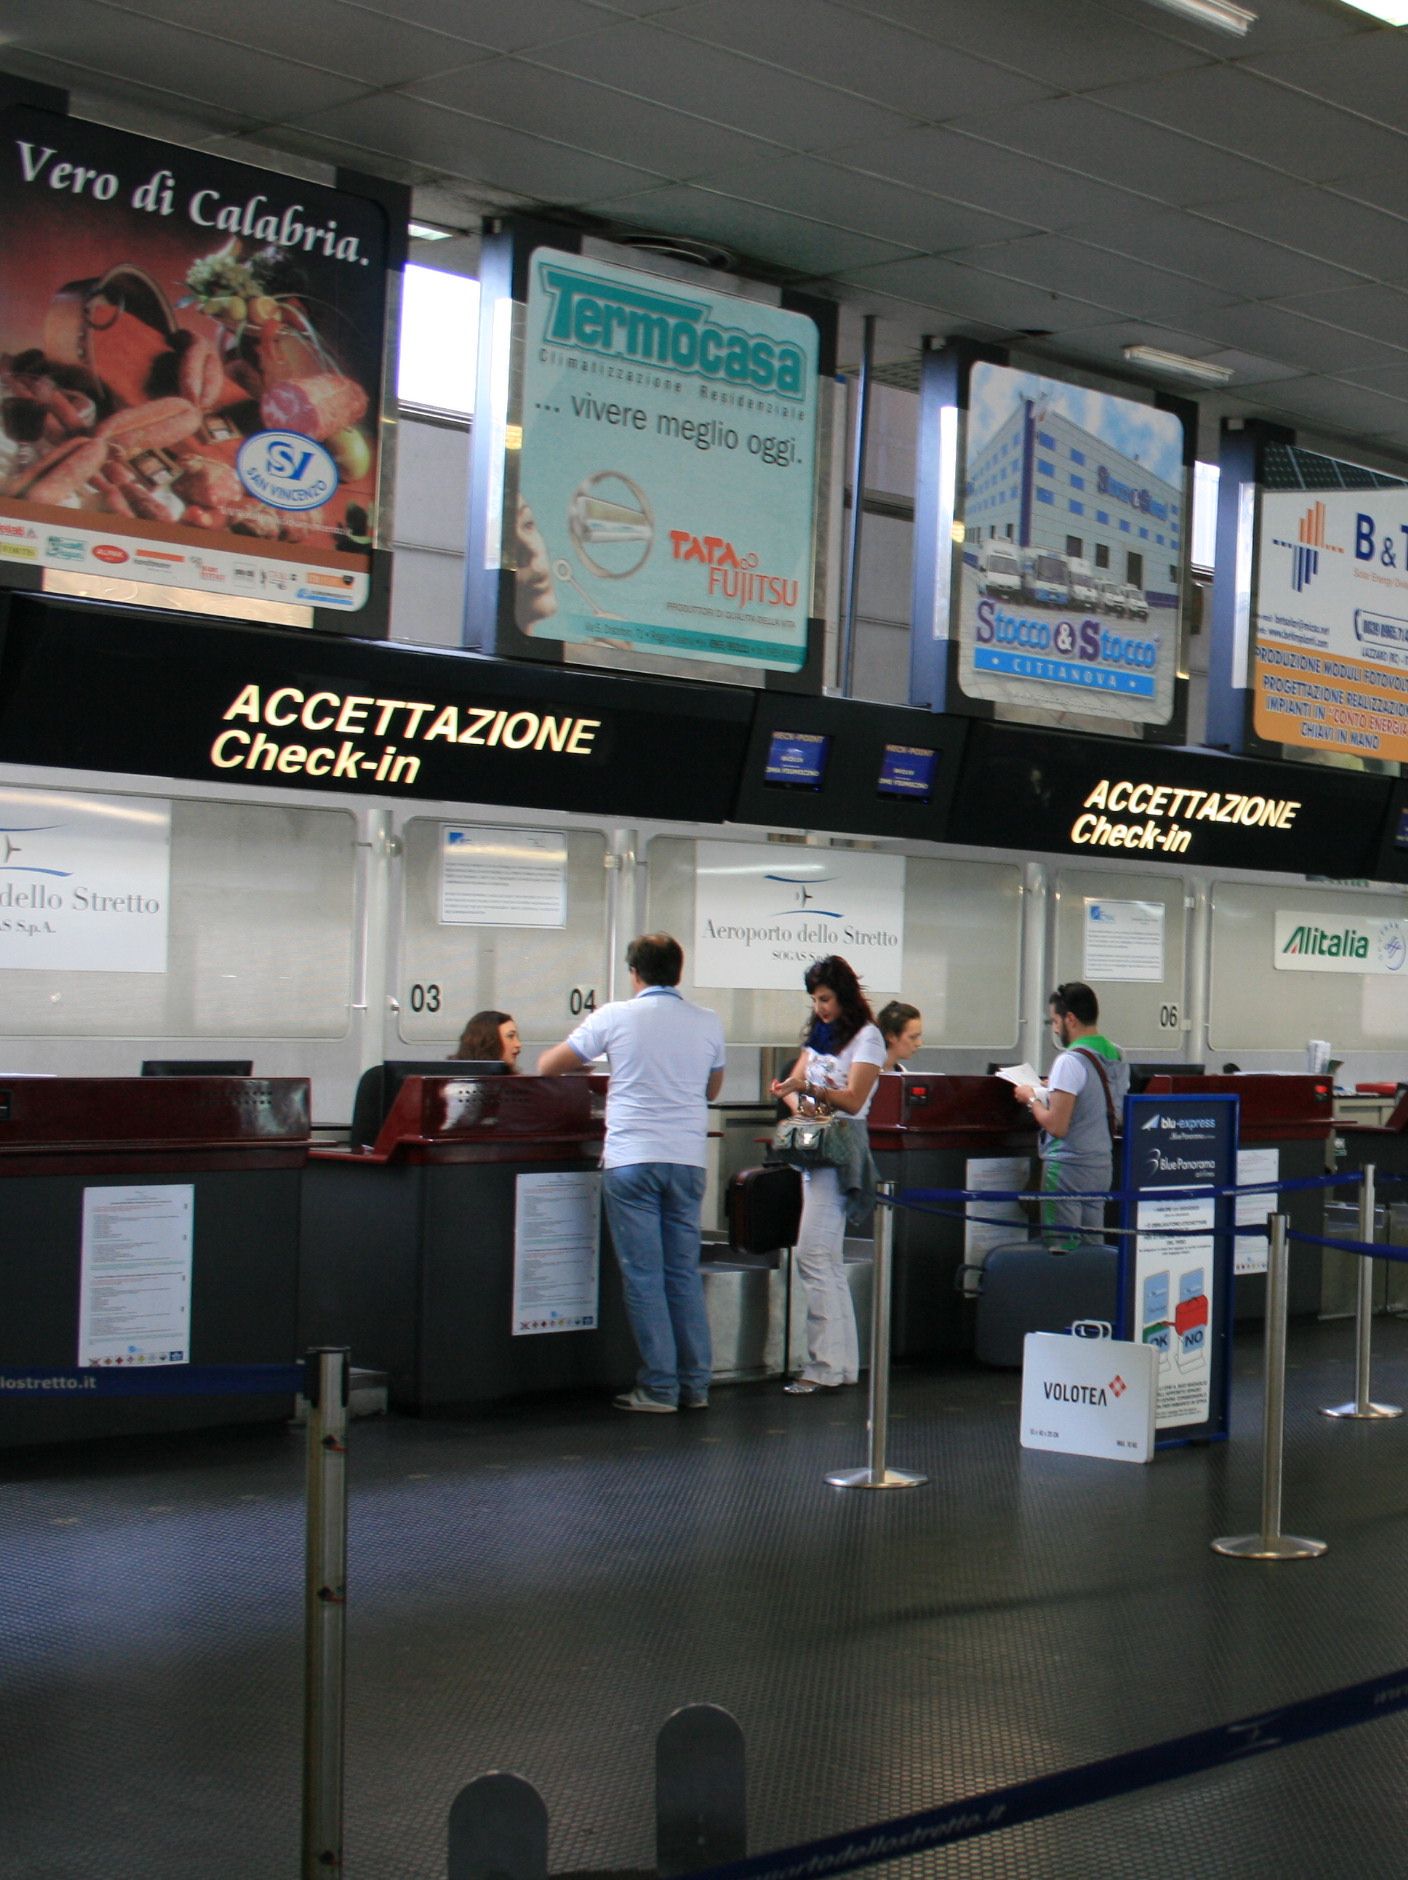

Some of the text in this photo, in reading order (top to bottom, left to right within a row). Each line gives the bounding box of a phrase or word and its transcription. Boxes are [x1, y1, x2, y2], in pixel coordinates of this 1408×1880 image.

[16, 140, 371, 267] Vero di Calabria.
[546, 268, 801, 394] Termocasa
[539, 347, 806, 421] Climatizzazione Residenziale
[571, 391, 648, 430] vivere
[656, 412, 739, 451] meglio
[747, 433, 803, 468] oggi.
[246, 467, 328, 502] SAN VINCENZO
[669, 530, 741, 569] TATA
[708, 565, 799, 608] FUJITSU
[975, 600, 1157, 668] Stocco & Stocco
[1012, 657, 1118, 688] CITTANOVA
[1255, 645, 1321, 674] PRODUZIONE
[1324, 660, 1362, 683] MODULI
[1263, 674, 1344, 705] PROGETTAZIONE
[223, 683, 601, 755] ACCETTAZIONE
[1266, 695, 1311, 719] IMPIANTI
[1314, 704, 1326, 721] IN
[1300, 721, 1381, 751] CHIAVI IN MANO
[210, 728, 421, 785] Check-in
[1083, 779, 1301, 829] ACCETTAZIONE
[1070, 812, 1193, 853] Check-in
[0, 883, 160, 915] dello Stretto
[702, 918, 898, 948] Aeroporto dello Stretto
[1282, 925, 1370, 960] Alitalia
[772, 950, 807, 962] SOGAS
[410, 983, 441, 1013] 03
[569, 987, 598, 1016] 04
[1160, 1004, 1178, 1028] 06
[1160, 1116, 1216, 1131] blu-express
[1184, 1332, 1204, 1348] NO
[1043, 1381, 1108, 1407] VOLOTEA
